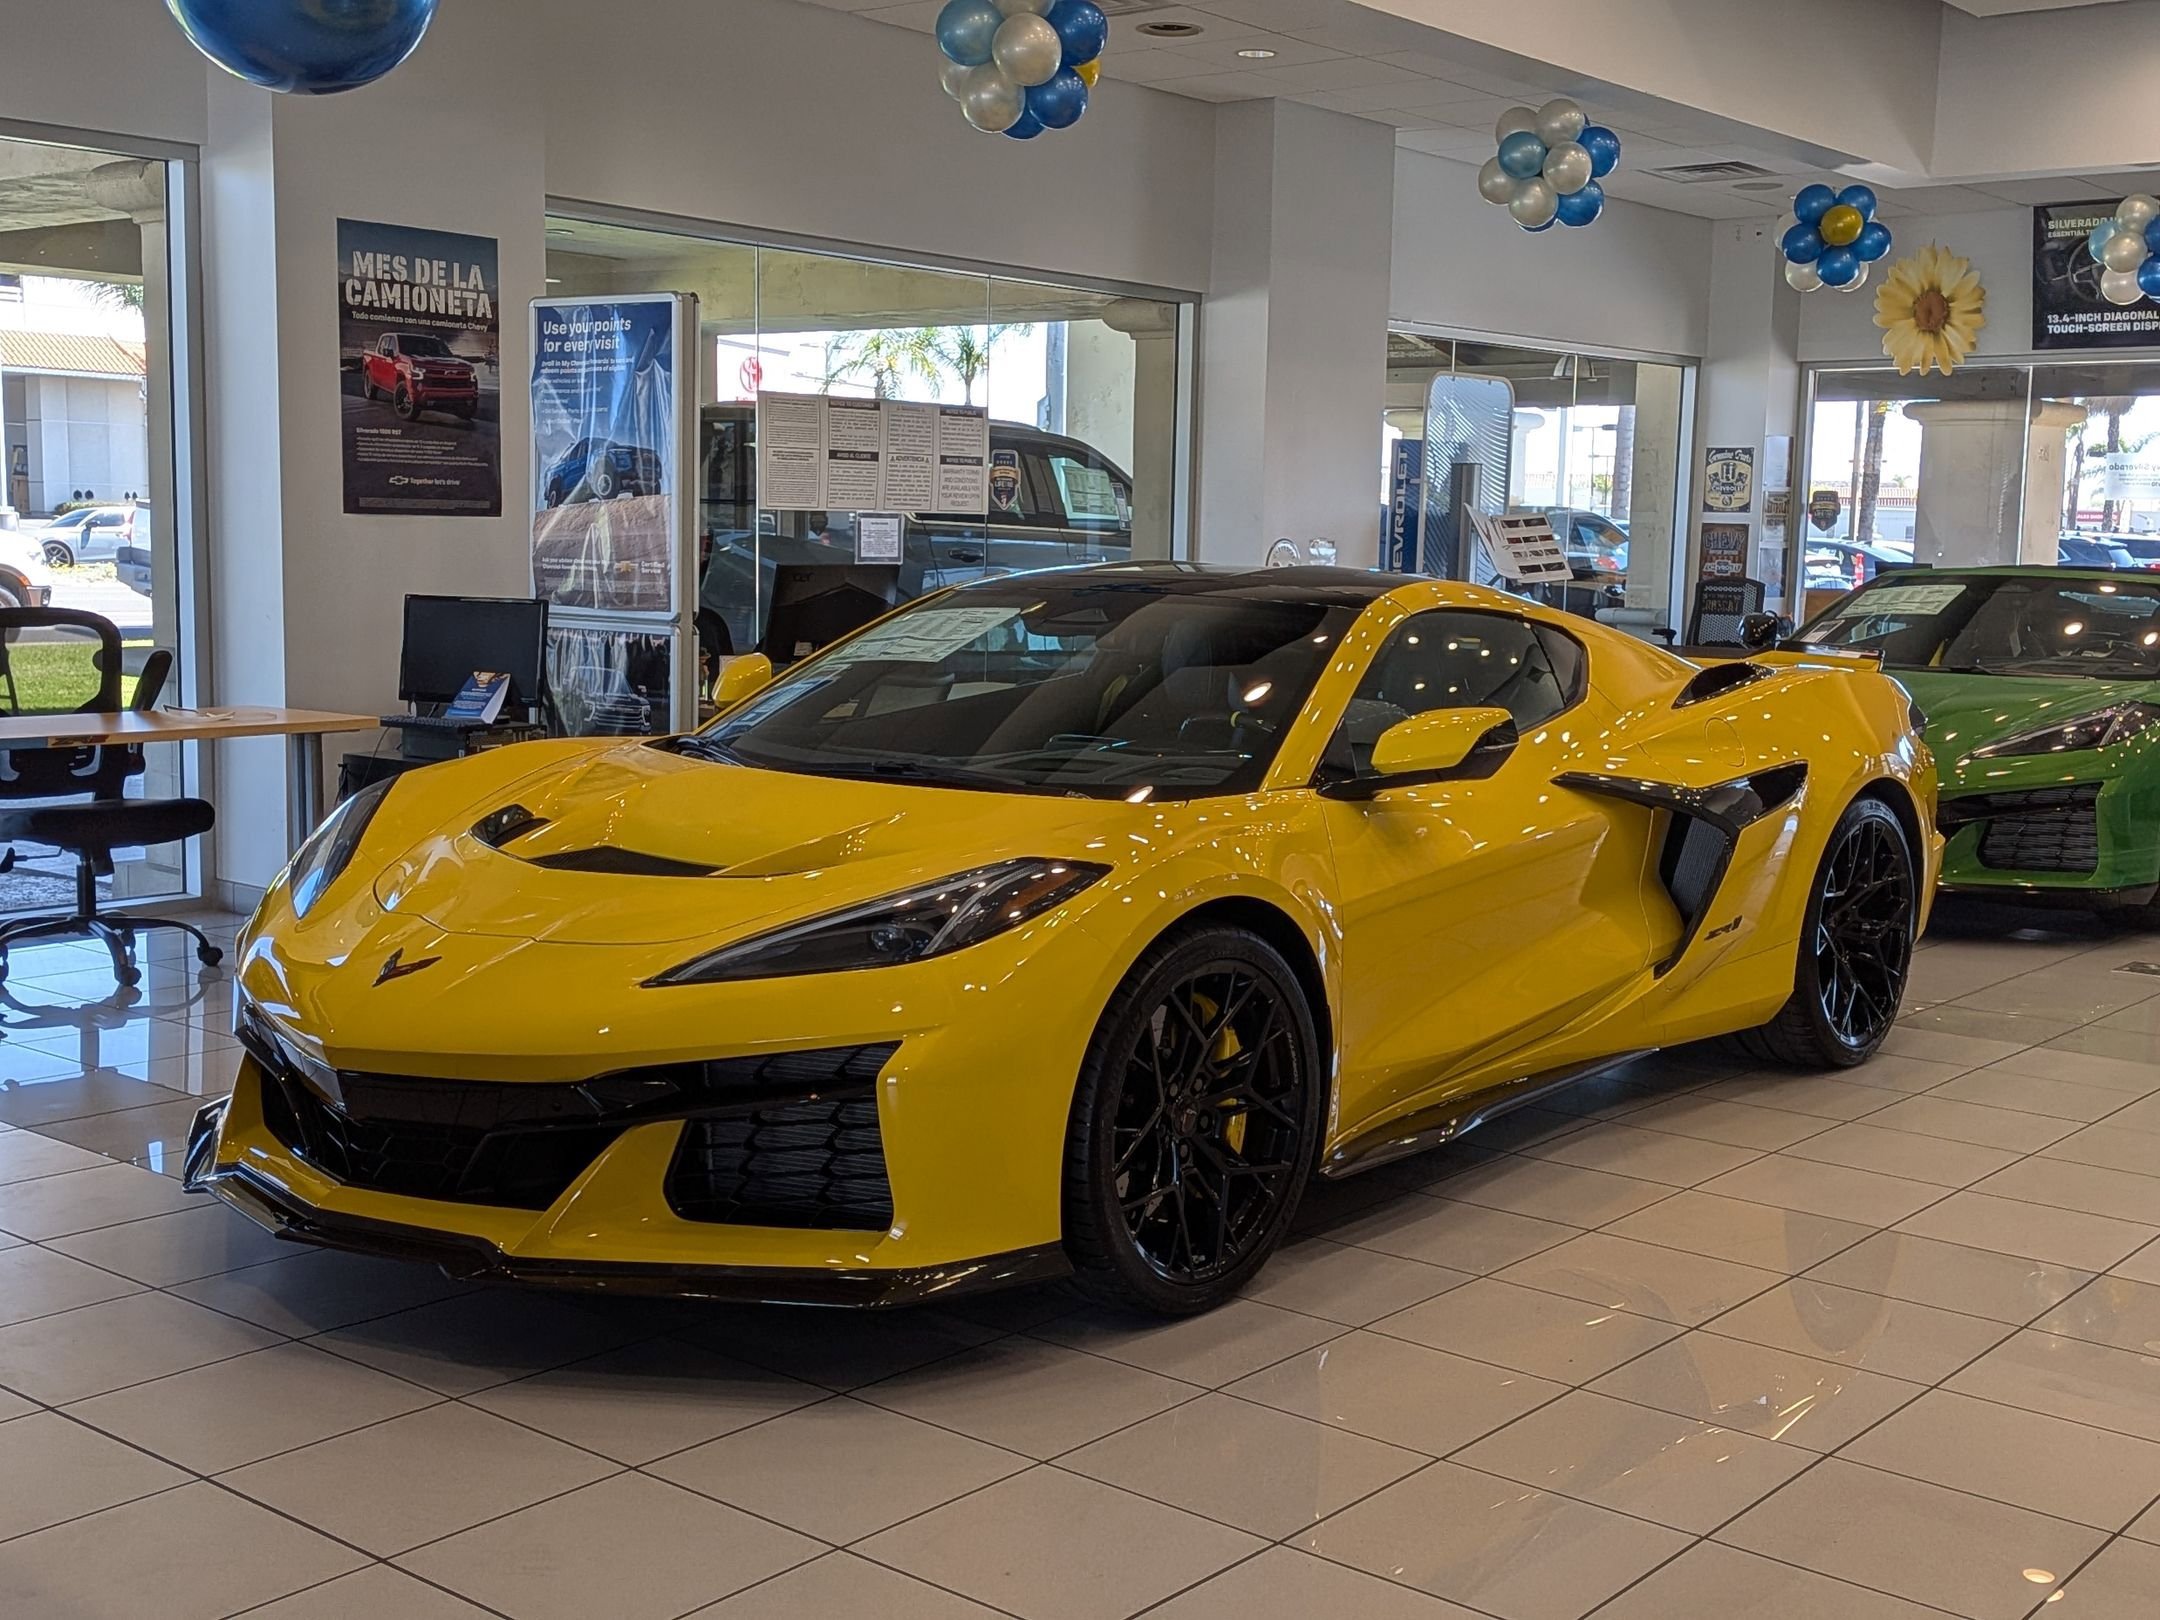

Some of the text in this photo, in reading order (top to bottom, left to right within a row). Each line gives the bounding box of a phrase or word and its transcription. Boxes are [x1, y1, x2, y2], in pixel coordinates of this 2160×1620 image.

[2048, 229, 2087, 238] ESSENTIAL
[353, 251, 484, 290] MES DE LA
[345, 279, 492, 318] CAMIONETA
[352, 311, 368, 319] Todo
[370, 314, 403, 322] comienza
[432, 320, 466, 329] camioneta
[468, 322, 487, 332] Chevy
[2047, 310, 2159, 323] 13.4-INCH DIAGONAL
[543, 317, 631, 337] Use your points
[2047, 322, 2131, 334] TOUCH-SCREEN
[544, 335, 620, 353] for every visit
[1703, 531, 1746, 550] CHEVY
[1704, 563, 1742, 572] CHEVROLET
